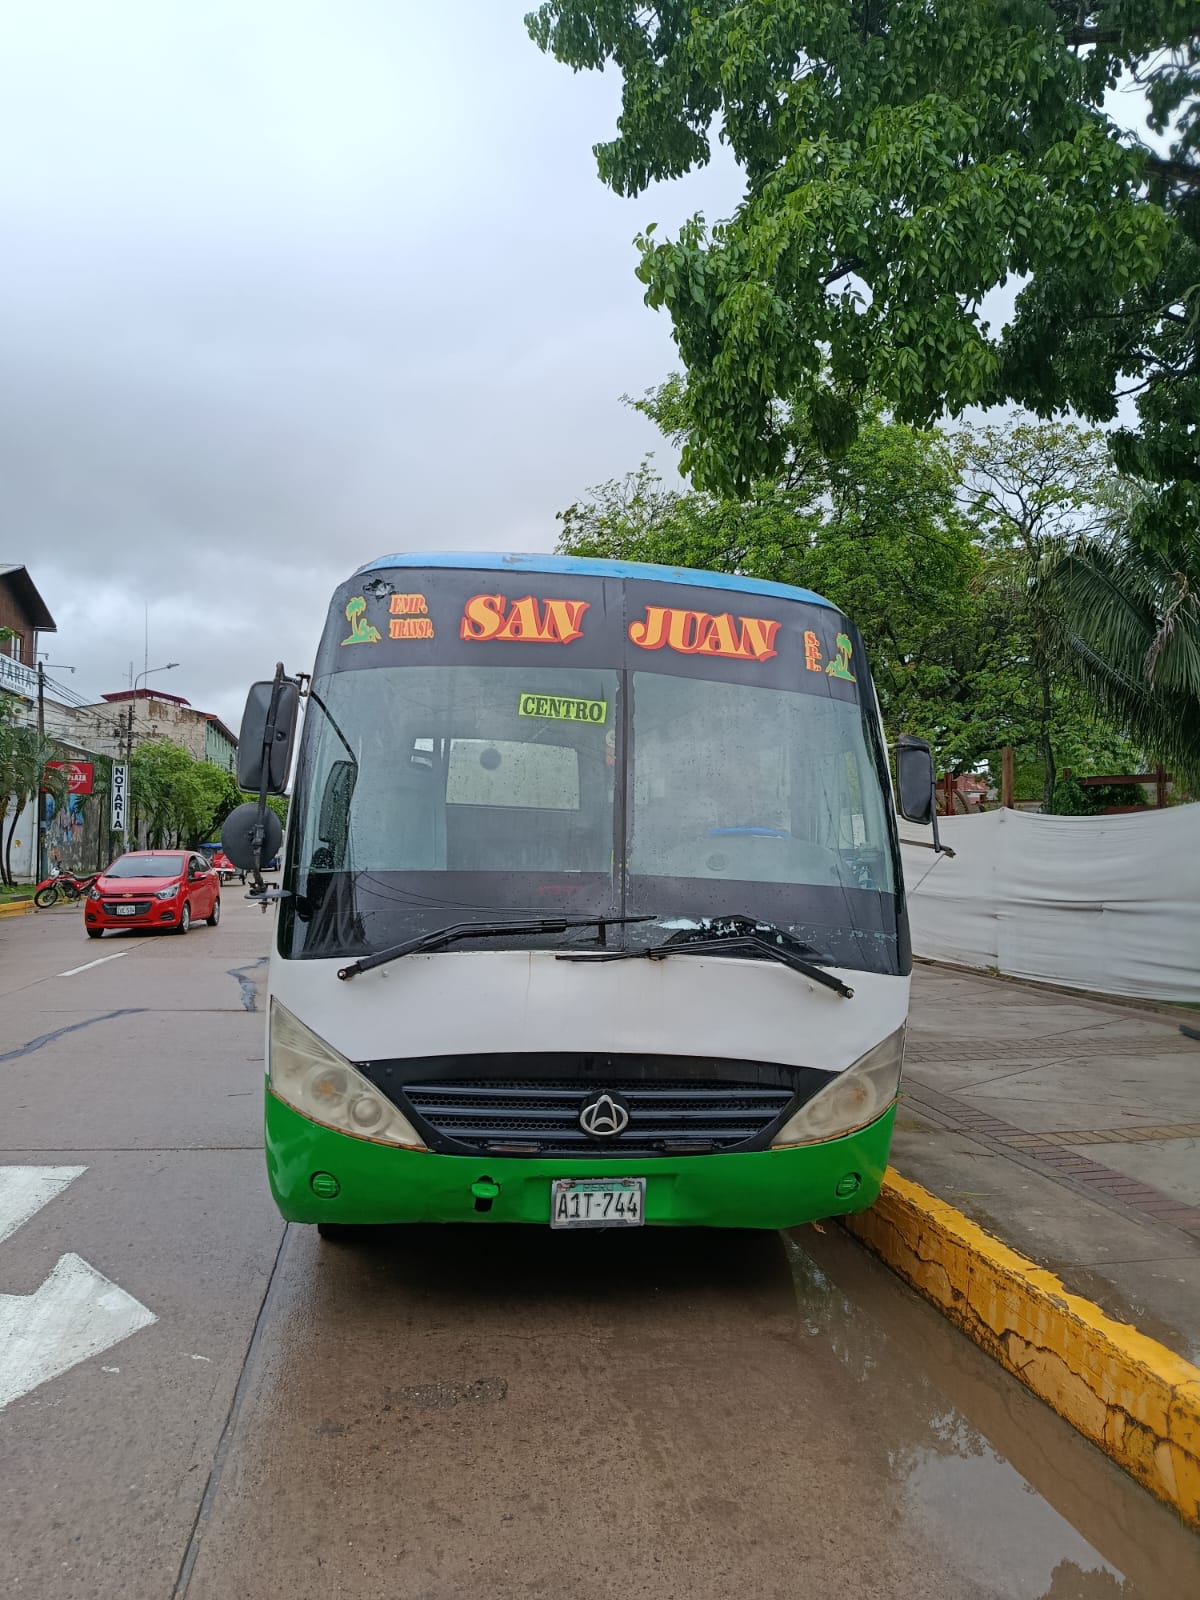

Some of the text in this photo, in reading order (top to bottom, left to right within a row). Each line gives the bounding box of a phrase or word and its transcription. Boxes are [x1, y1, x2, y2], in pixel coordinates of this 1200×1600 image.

[389, 593, 428, 614] EMP.
[390, 618, 435, 639] TRANSP.
[460, 594, 782, 662] SAN JUAN
[521, 696, 603, 722] CENTRO
[113, 767, 125, 829] NOTARIA
[557, 1192, 639, 1219] A1T-744
